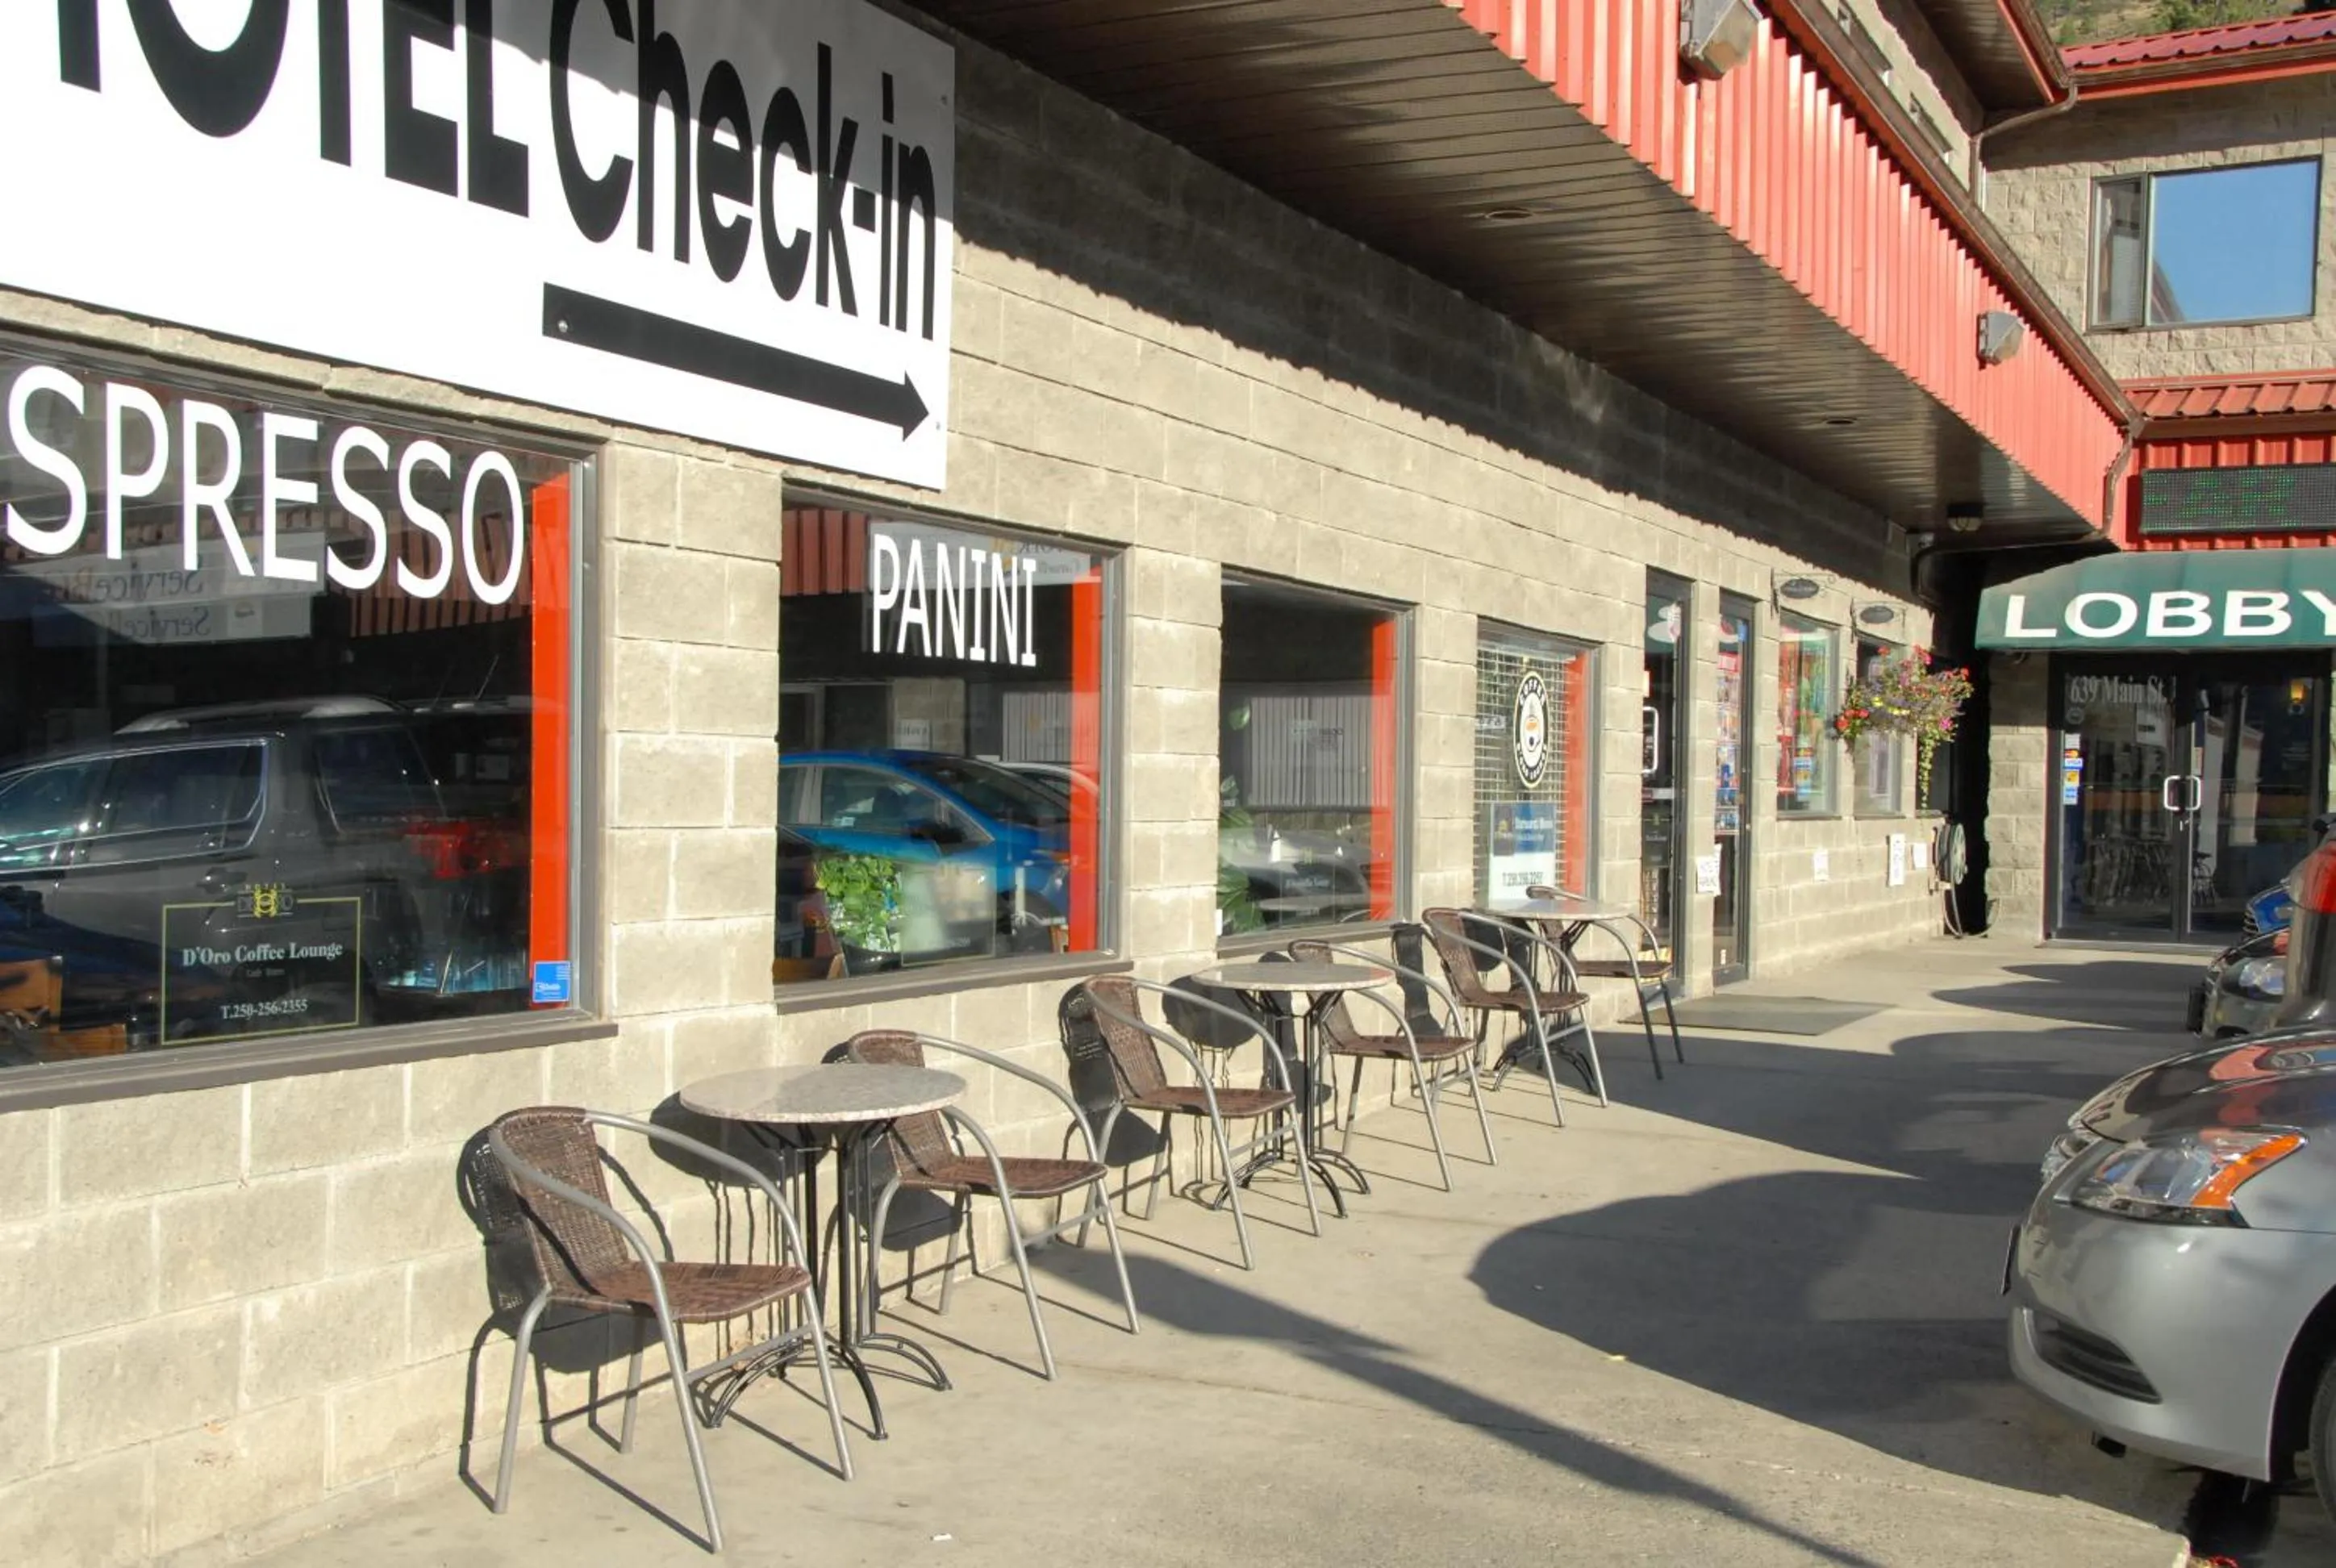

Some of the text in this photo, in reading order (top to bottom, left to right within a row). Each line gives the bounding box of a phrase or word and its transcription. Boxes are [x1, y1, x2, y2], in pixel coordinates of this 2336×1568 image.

[550, 0, 936, 340] Check-in
[6, 365, 524, 606] SPRESSO
[873, 533, 1037, 666] PANINI
[2004, 590, 2336, 638] LOBBY
[2071, 675, 2097, 703] 639
[2101, 675, 2142, 704] Main
[182, 941, 344, 966] D'Oro Coffee Lounge
